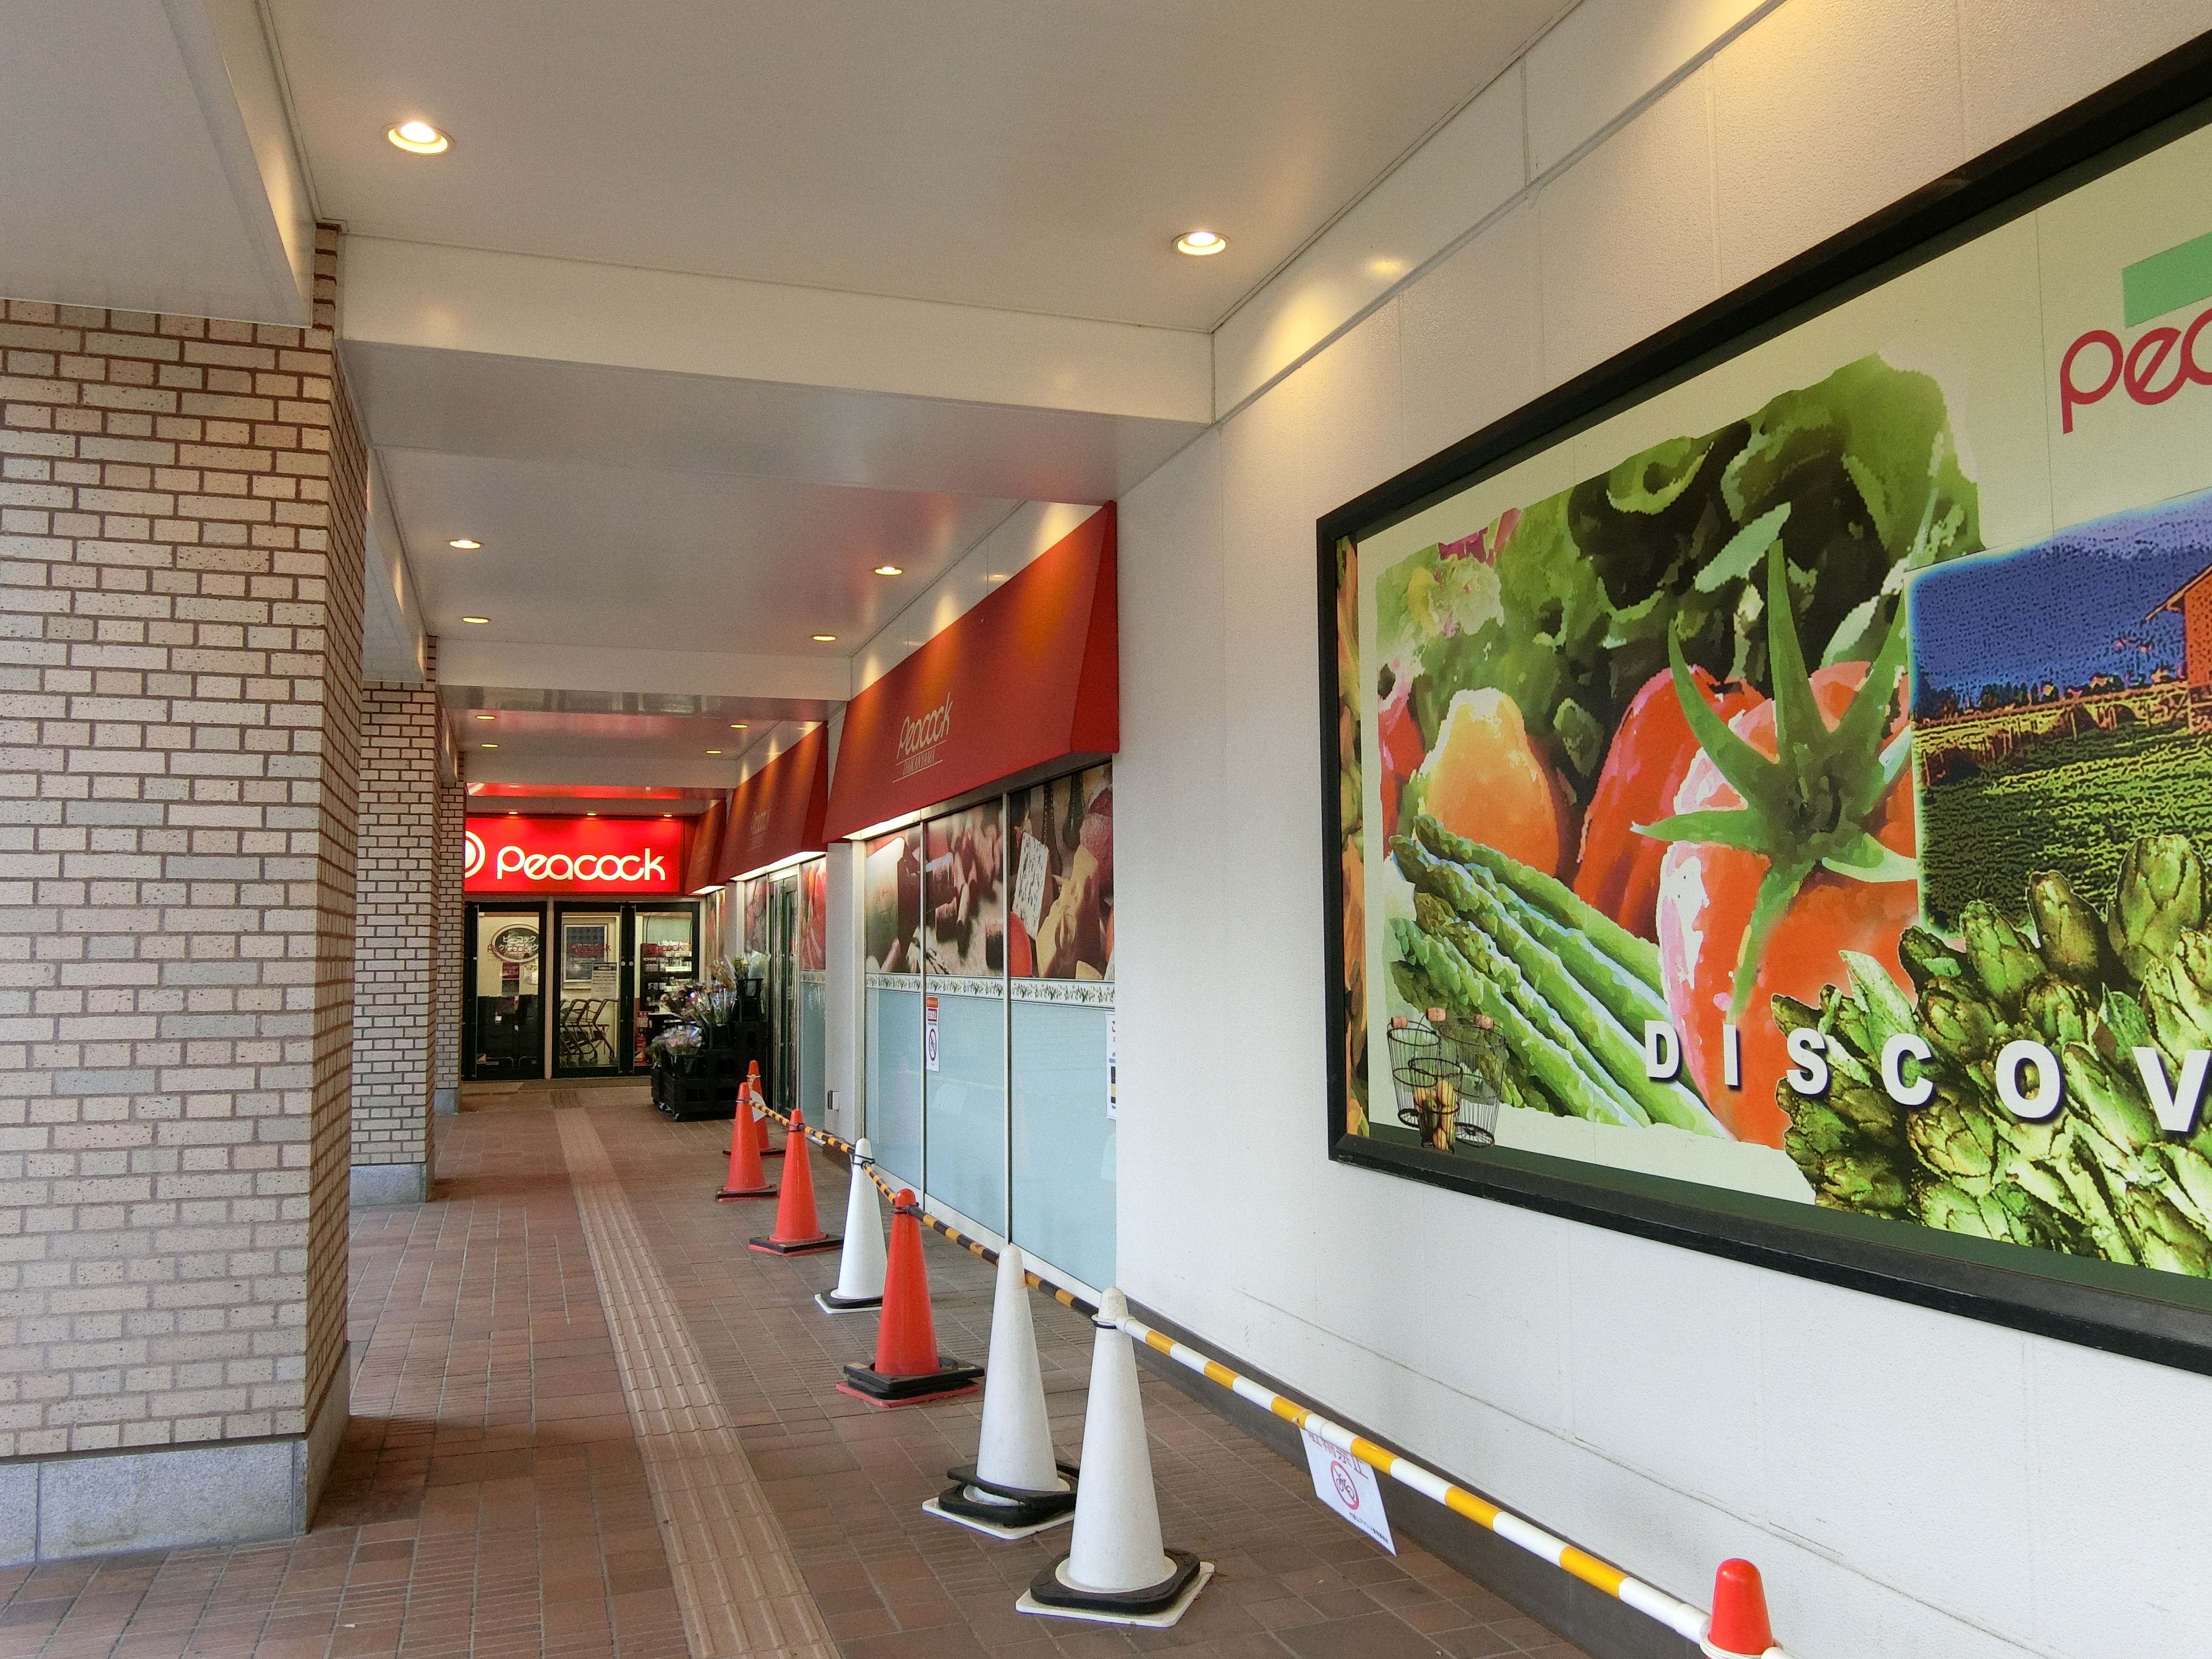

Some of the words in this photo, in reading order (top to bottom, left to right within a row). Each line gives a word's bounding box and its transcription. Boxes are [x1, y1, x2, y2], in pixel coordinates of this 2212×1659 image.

[896, 692, 953, 759] Peacock
[902, 748, 935, 776] DAIKANYAMA
[497, 846, 666, 881] Peacock
[1644, 1020, 2211, 1133] DISCOV
